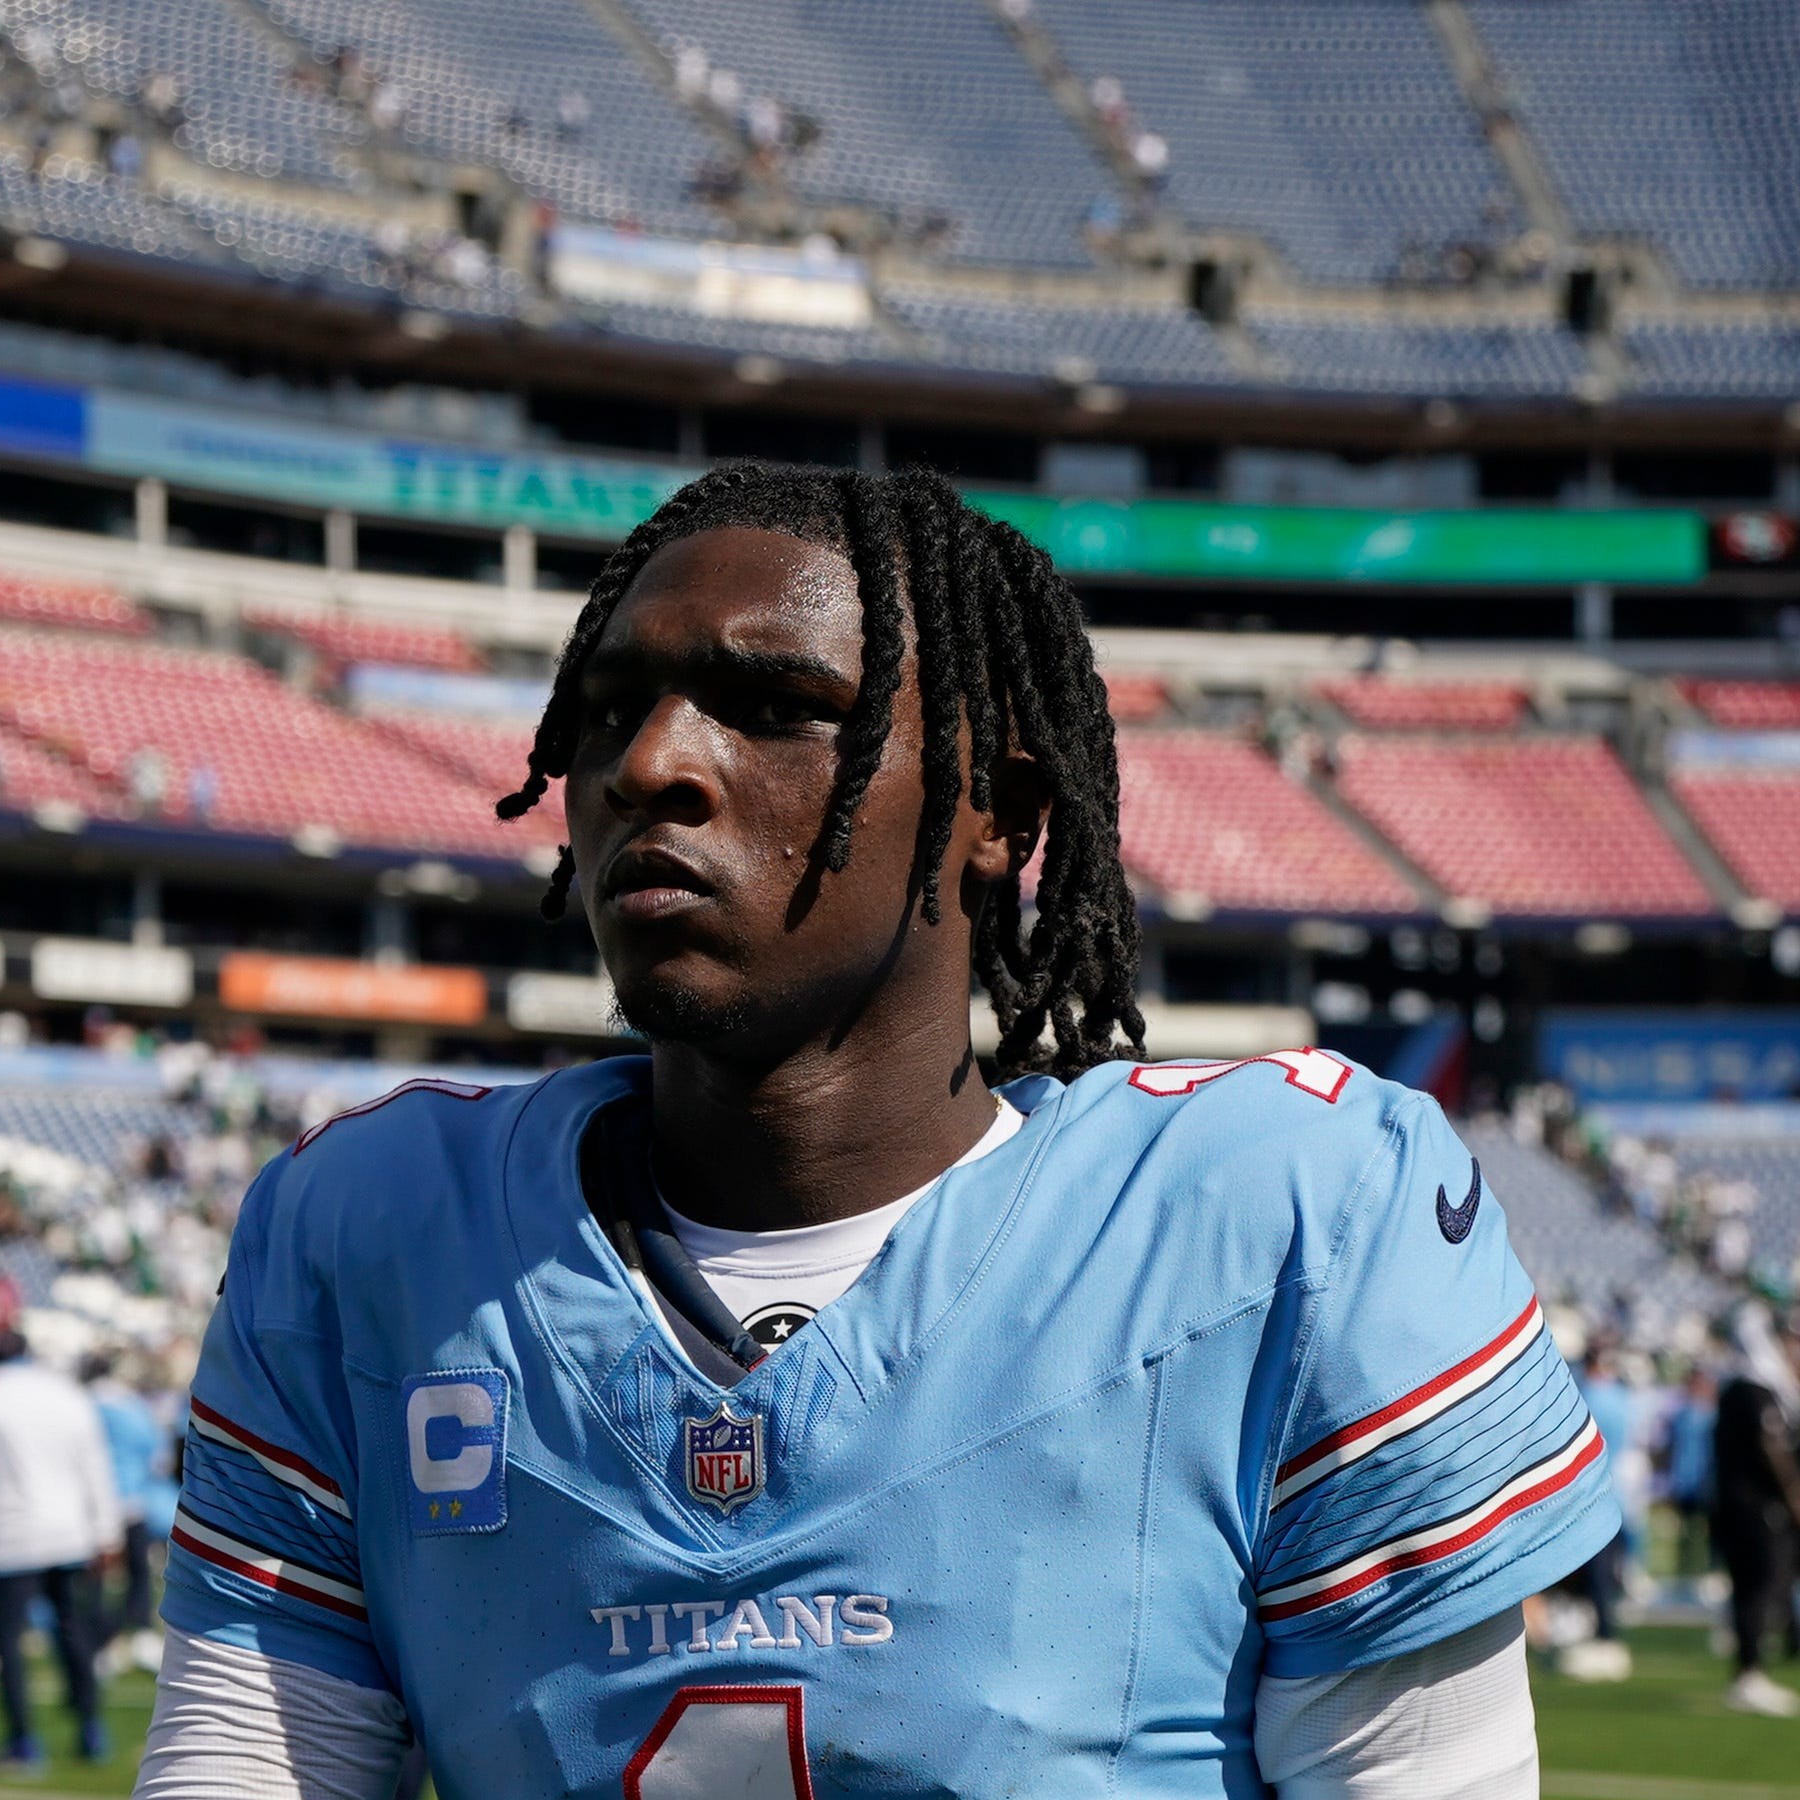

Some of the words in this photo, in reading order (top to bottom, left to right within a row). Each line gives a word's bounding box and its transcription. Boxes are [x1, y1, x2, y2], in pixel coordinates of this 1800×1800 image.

[406, 1382, 496, 1494] C
[696, 1452, 751, 1495] NFL
[590, 1594, 894, 1657] TITANS
